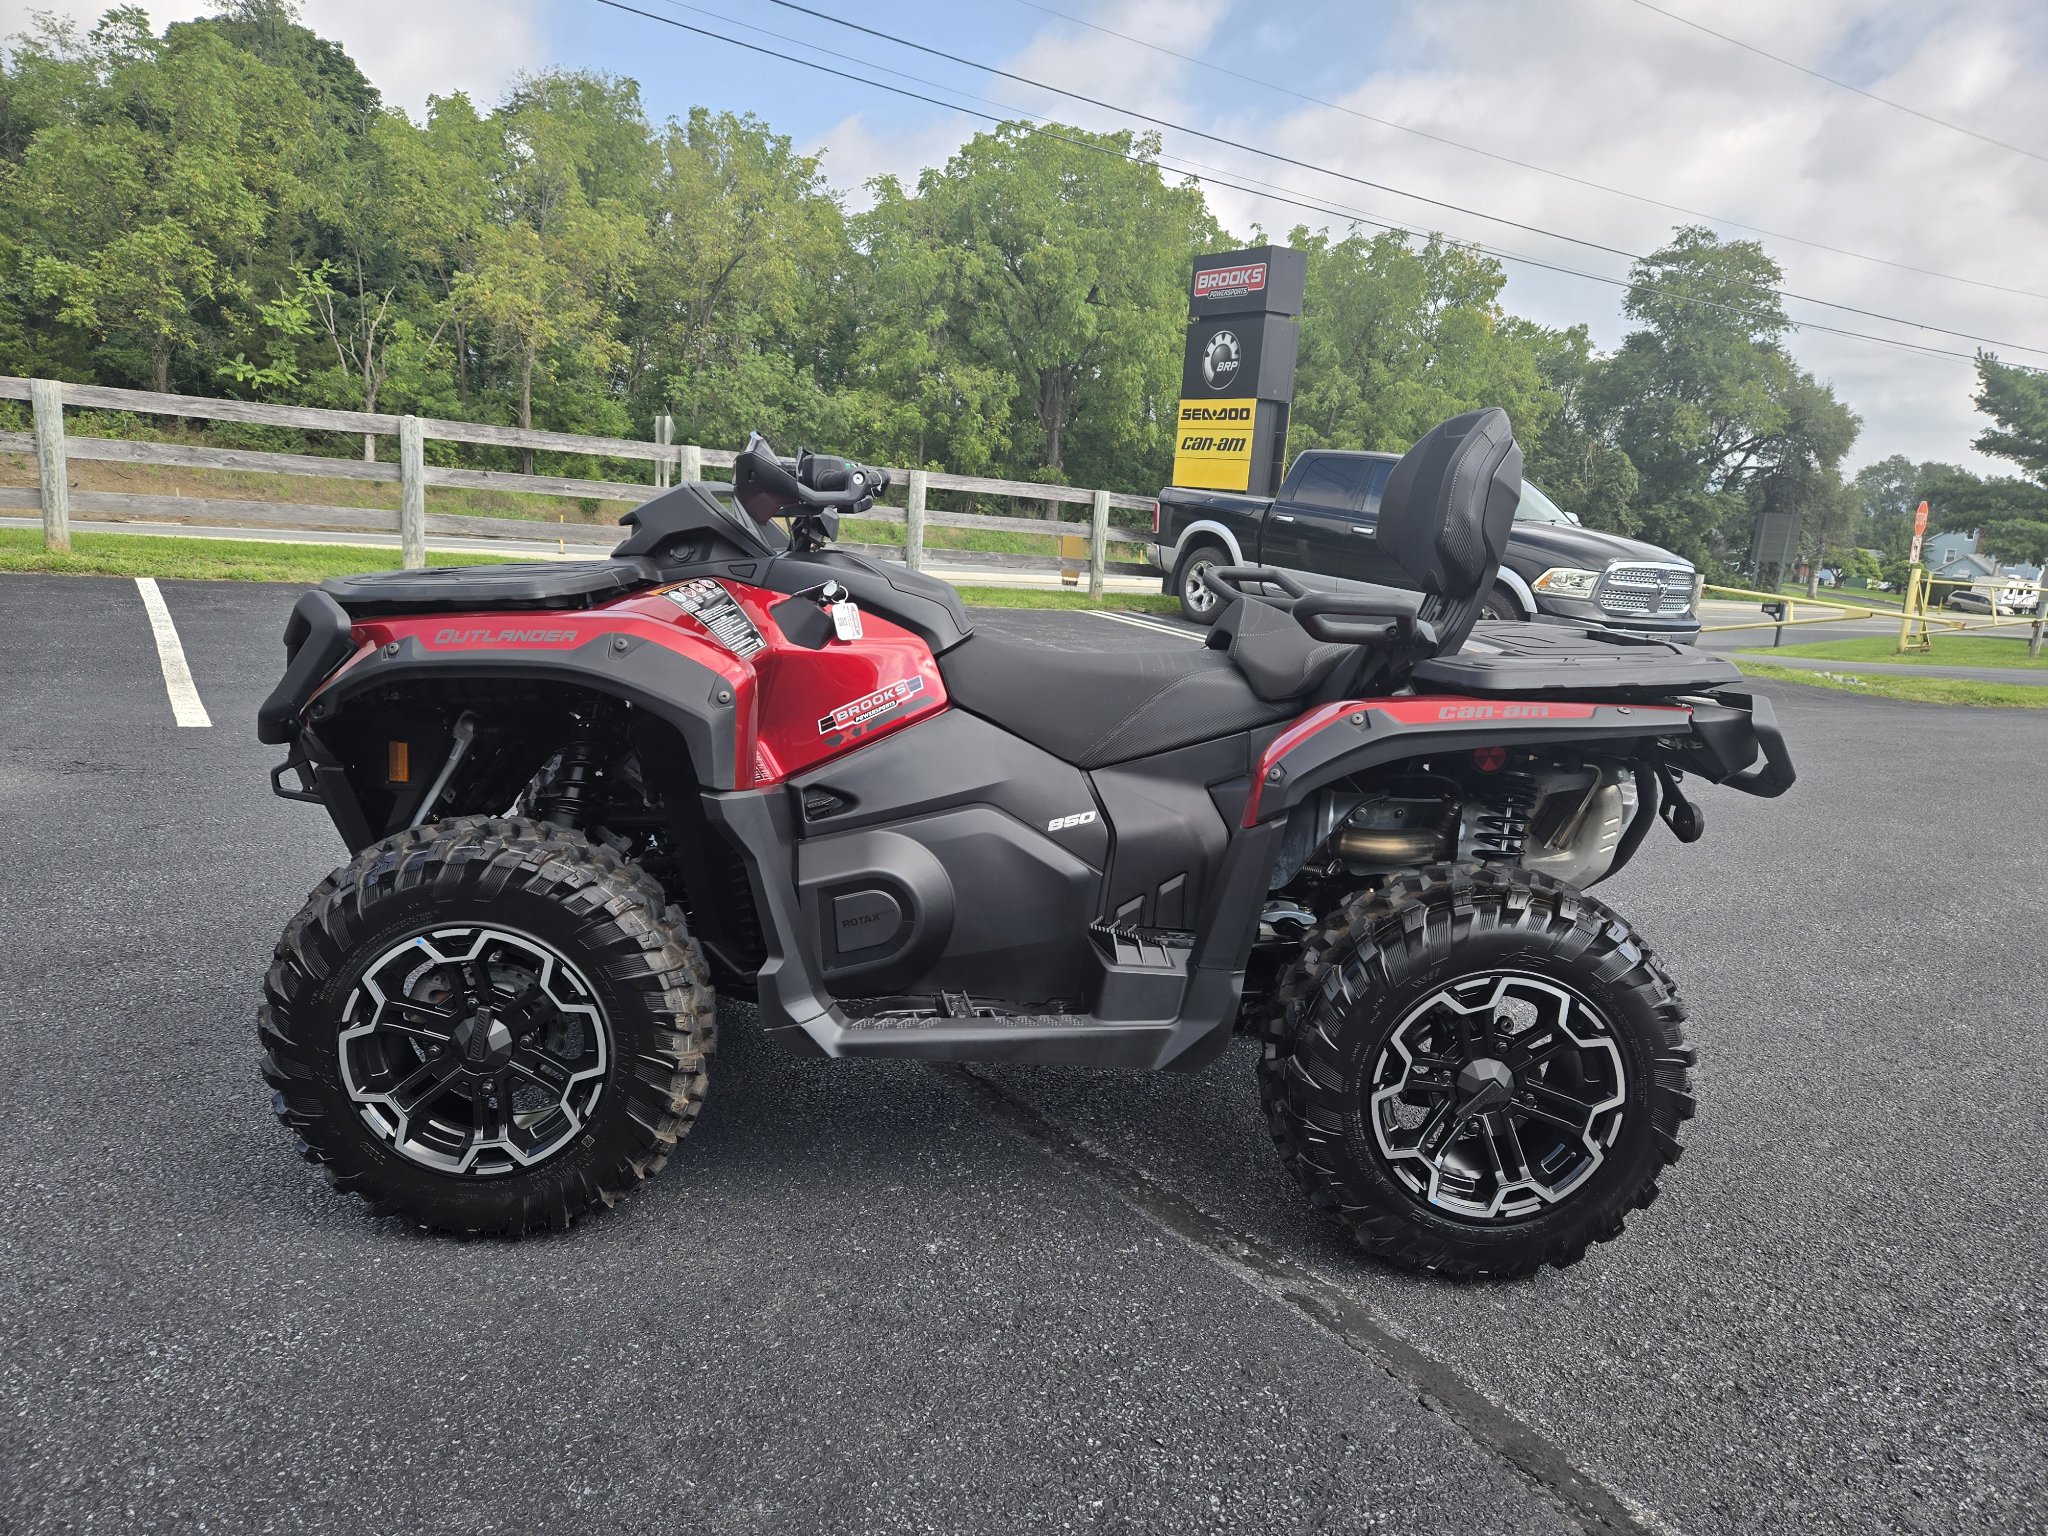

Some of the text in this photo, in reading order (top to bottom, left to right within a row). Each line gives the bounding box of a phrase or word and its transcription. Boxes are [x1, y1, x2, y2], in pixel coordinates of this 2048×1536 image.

[1198, 268, 1264, 289] BROOKS
[1210, 287, 1248, 298] POWERSPORTS
[1216, 361, 1239, 371] BRP
[434, 629, 578, 644] OUTLANDER
[837, 684, 907, 722] BROOKS
[1047, 810, 1097, 831] 850
[842, 913, 880, 929] ROTAX
